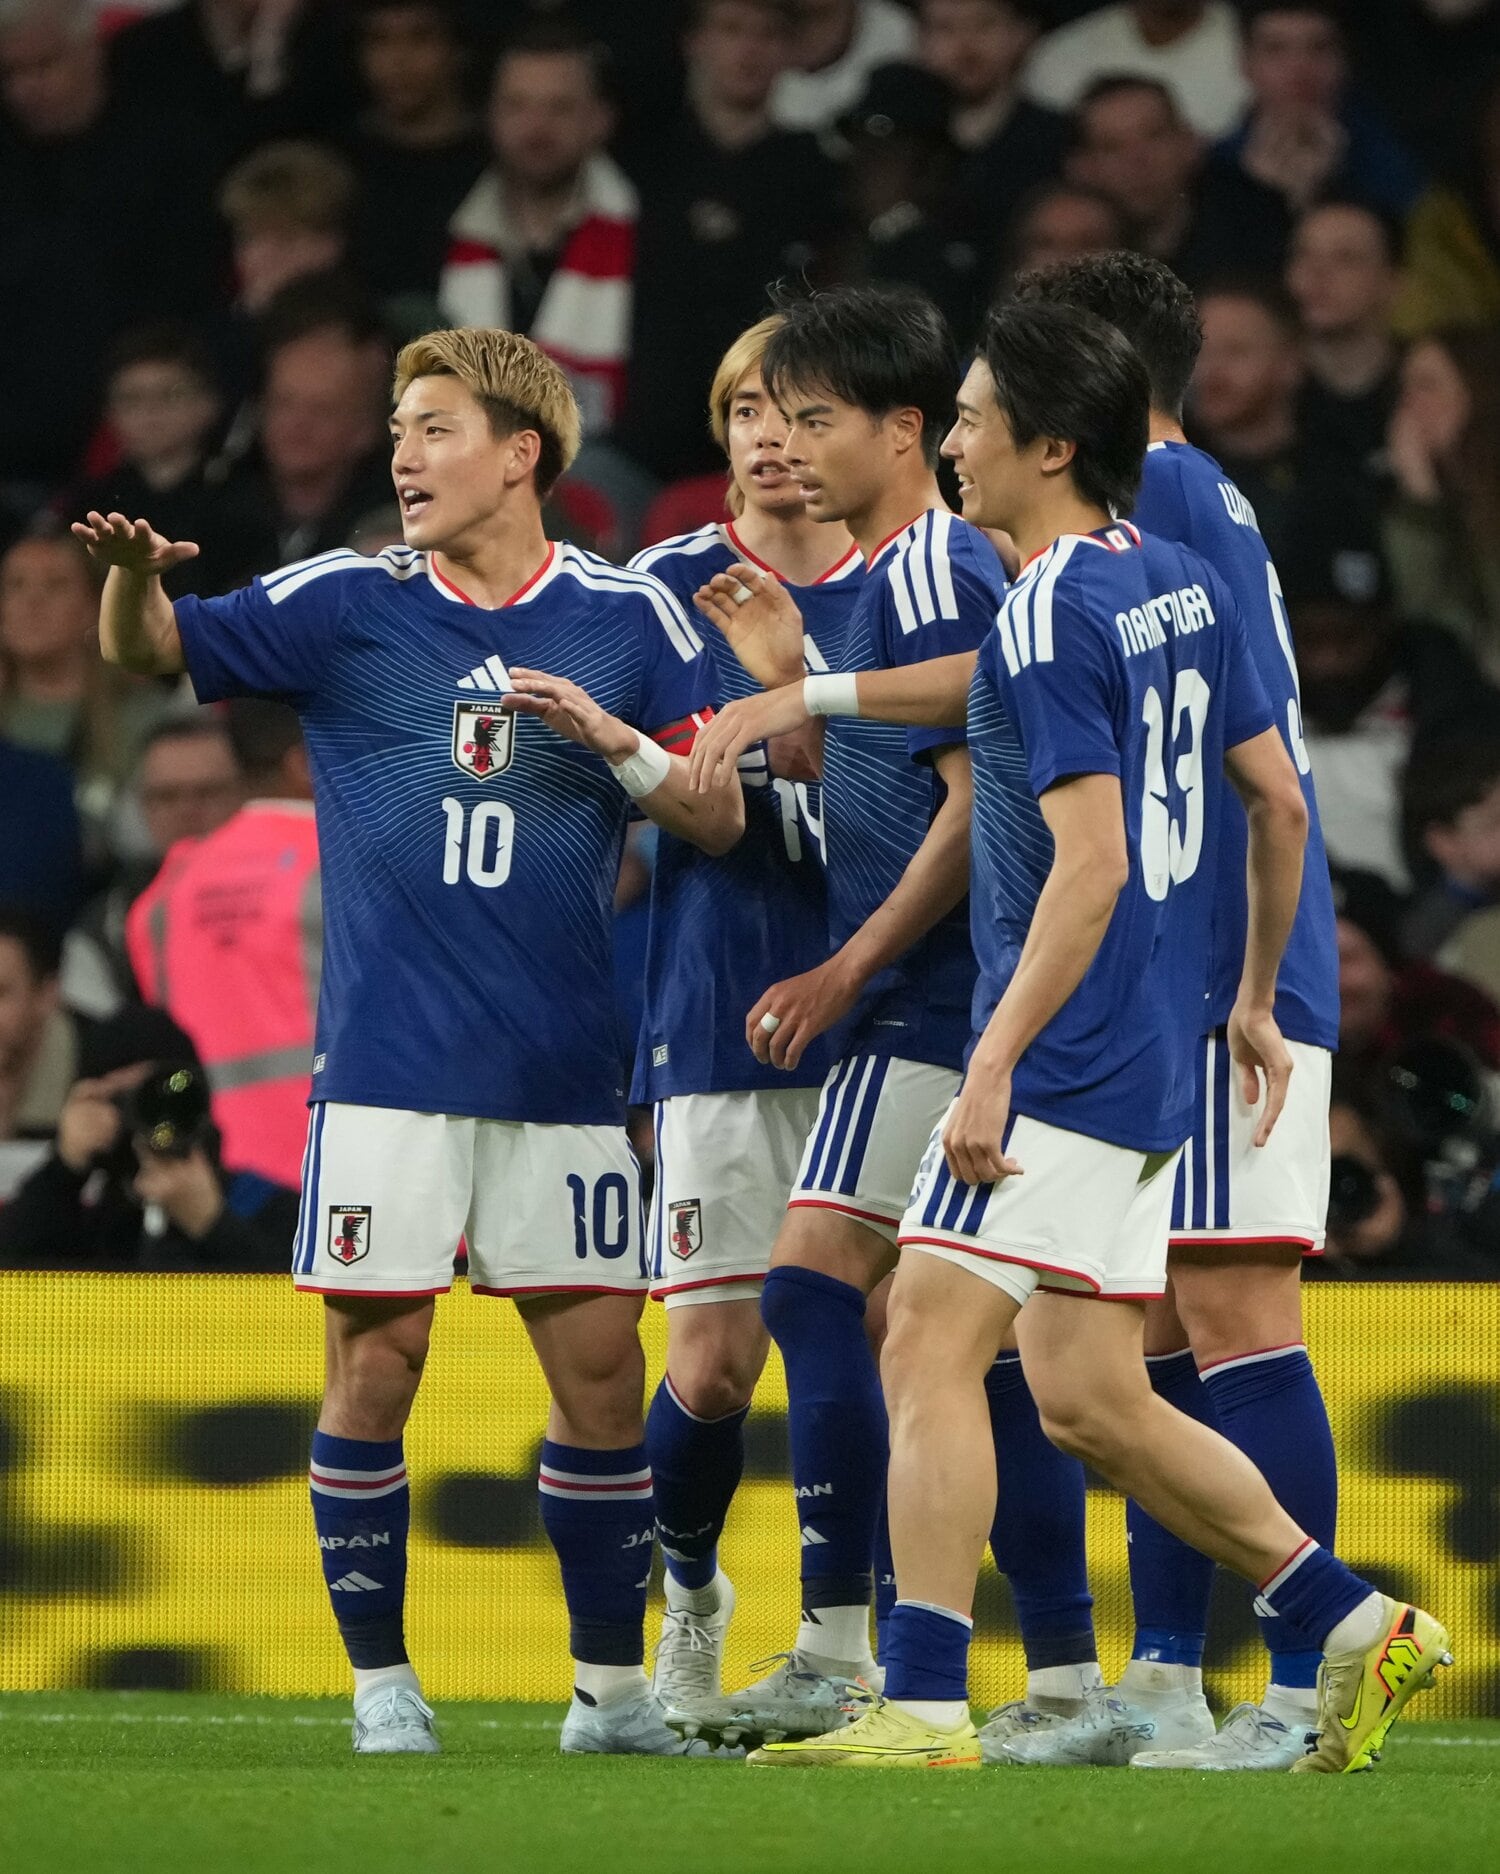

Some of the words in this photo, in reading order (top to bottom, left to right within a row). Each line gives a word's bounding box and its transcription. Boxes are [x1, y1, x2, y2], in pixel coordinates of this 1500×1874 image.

[470, 705, 502, 713] JAPAN
[1142, 669, 1211, 901] 13
[442, 797, 515, 888] 10
[567, 1172, 629, 1259] 10
[319, 1532, 390, 1550] APAN
